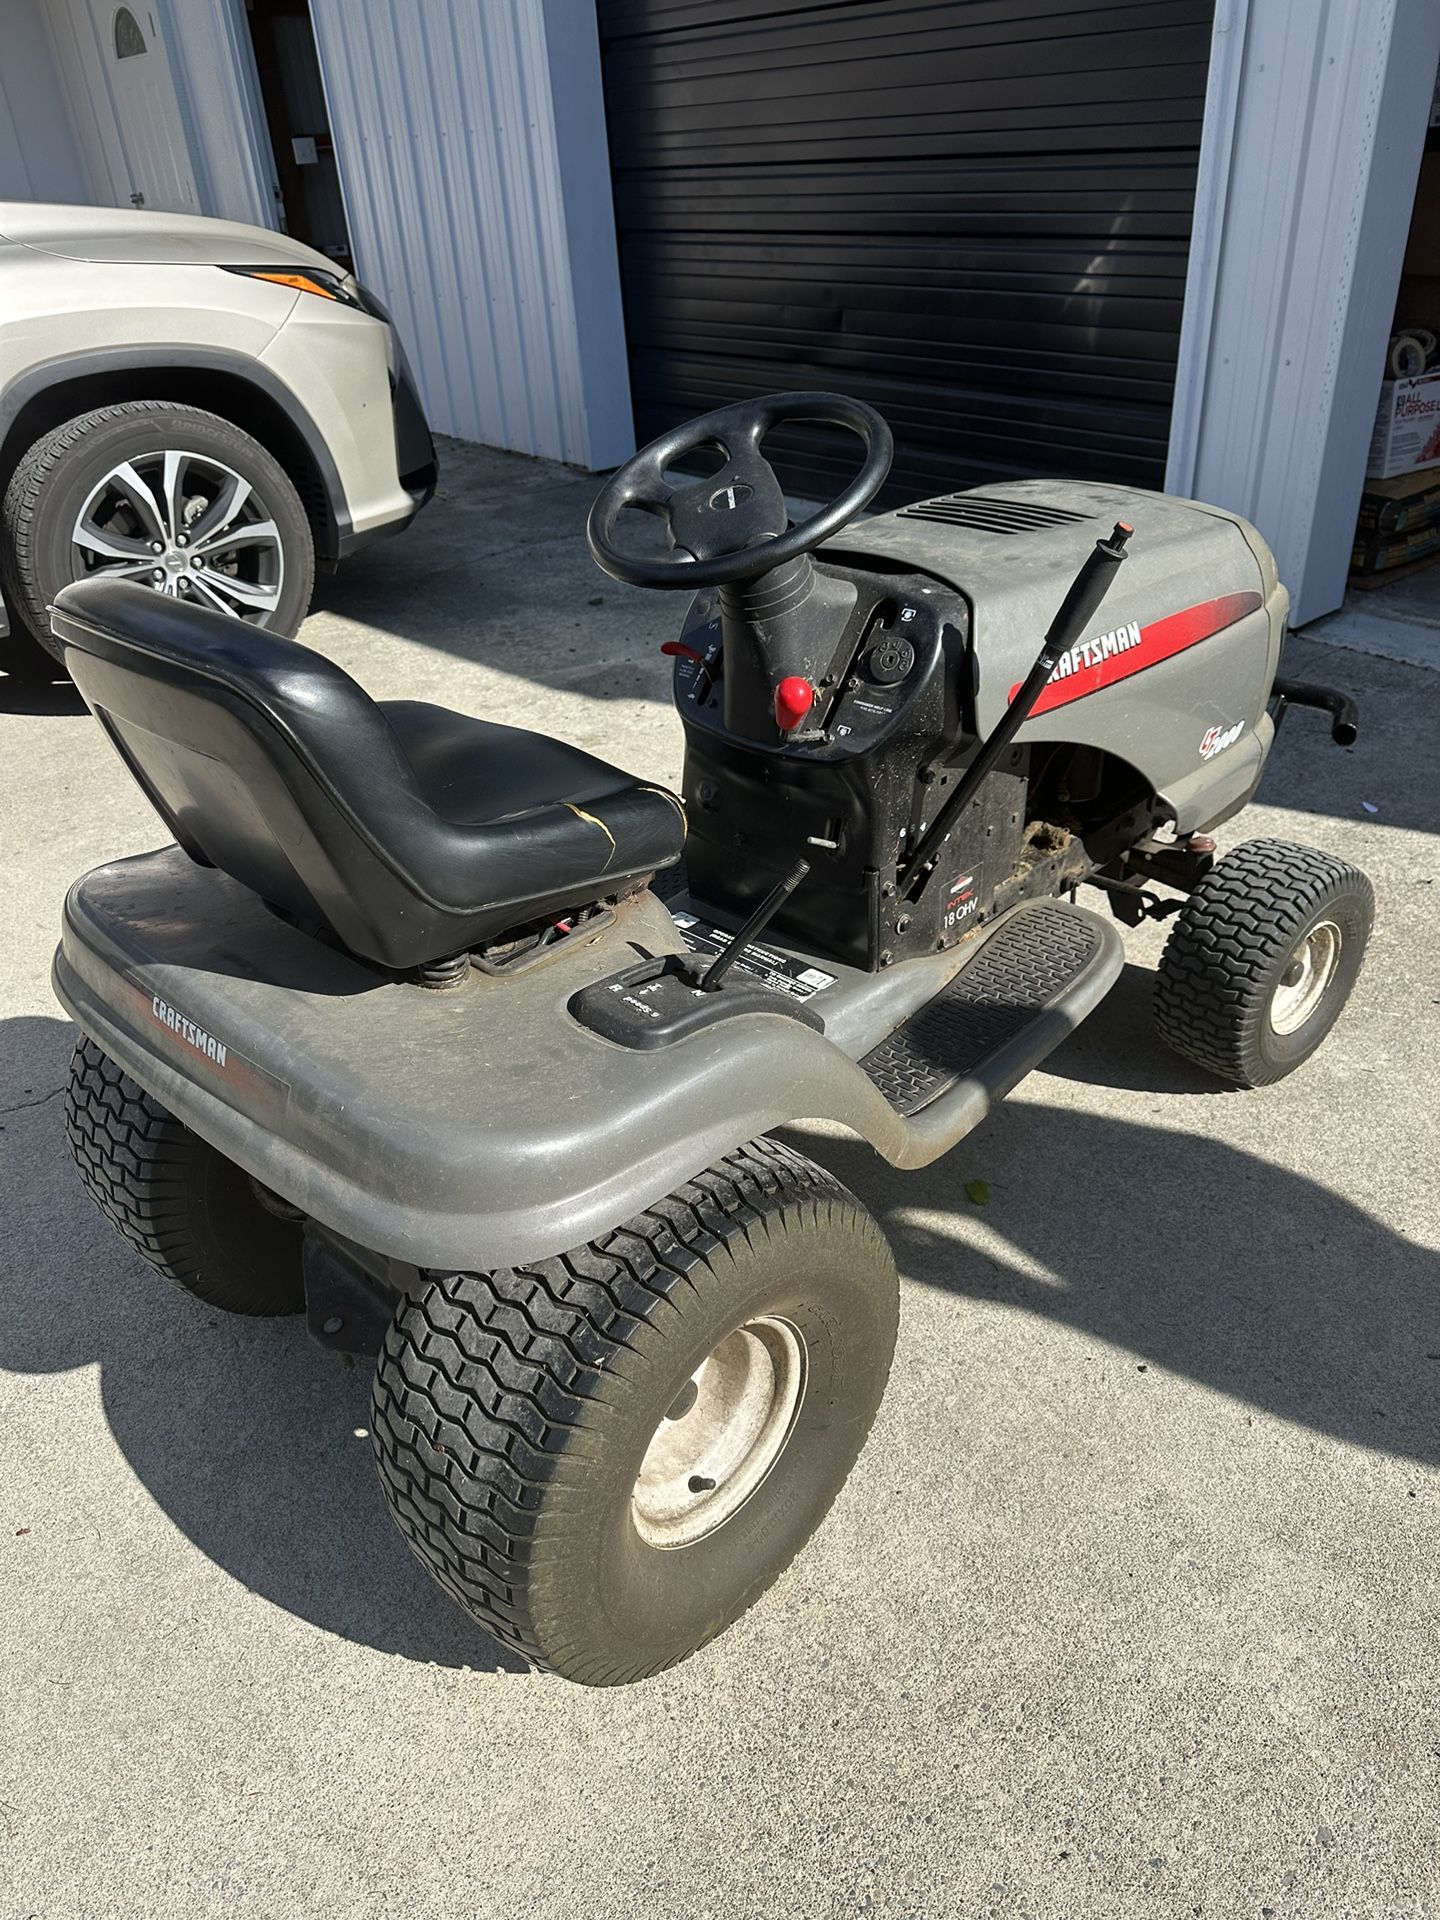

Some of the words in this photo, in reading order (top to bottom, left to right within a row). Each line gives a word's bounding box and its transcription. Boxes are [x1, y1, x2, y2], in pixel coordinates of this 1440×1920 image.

[1394, 399, 1436, 418] PURPOSE
[899, 827, 907, 838] 6
[943, 911, 956, 929] 18
[955, 896, 979, 920] OHV
[152, 995, 228, 1068] CRAFTSMAN
